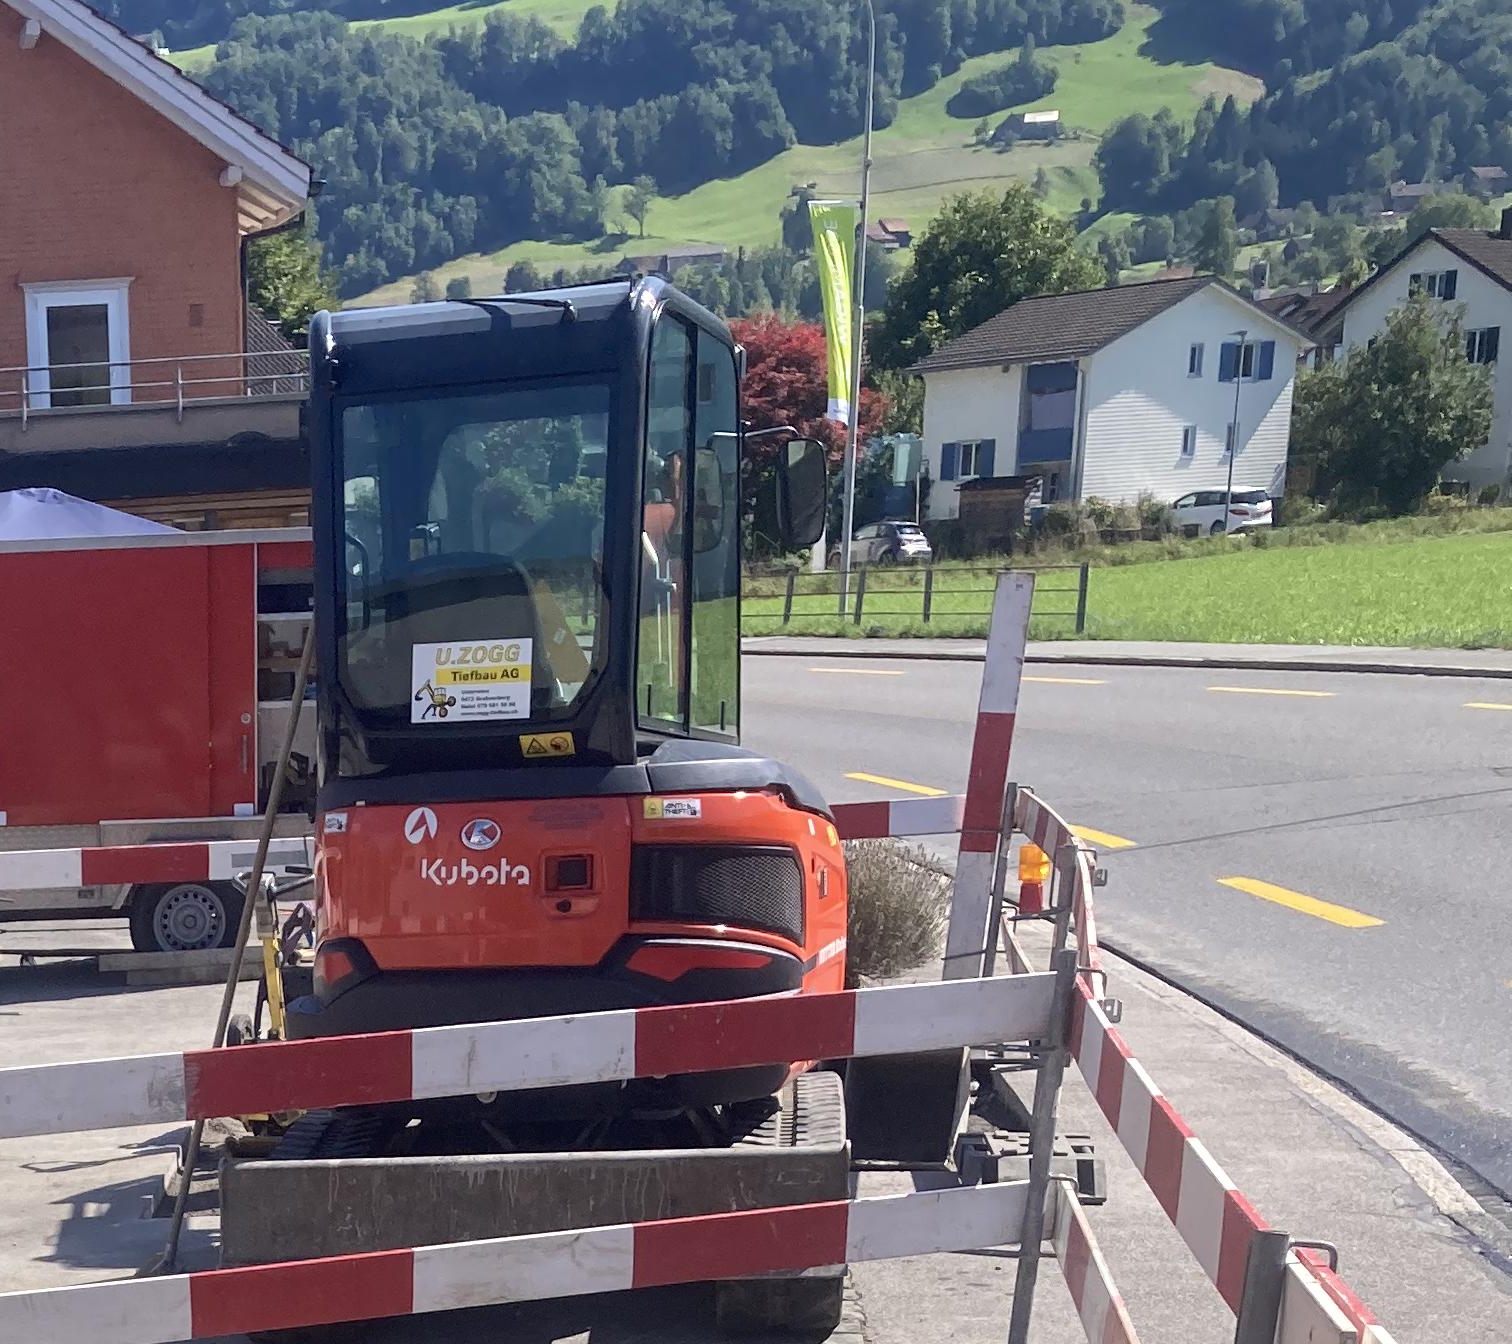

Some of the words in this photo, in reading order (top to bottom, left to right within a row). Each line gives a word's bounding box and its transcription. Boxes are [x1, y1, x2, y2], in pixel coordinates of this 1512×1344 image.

[435, 644, 521, 666] U.ZOGG
[450, 668, 498, 682] Tiefbau
[500, 668, 520, 679] AG
[420, 857, 531, 886] Kubota
